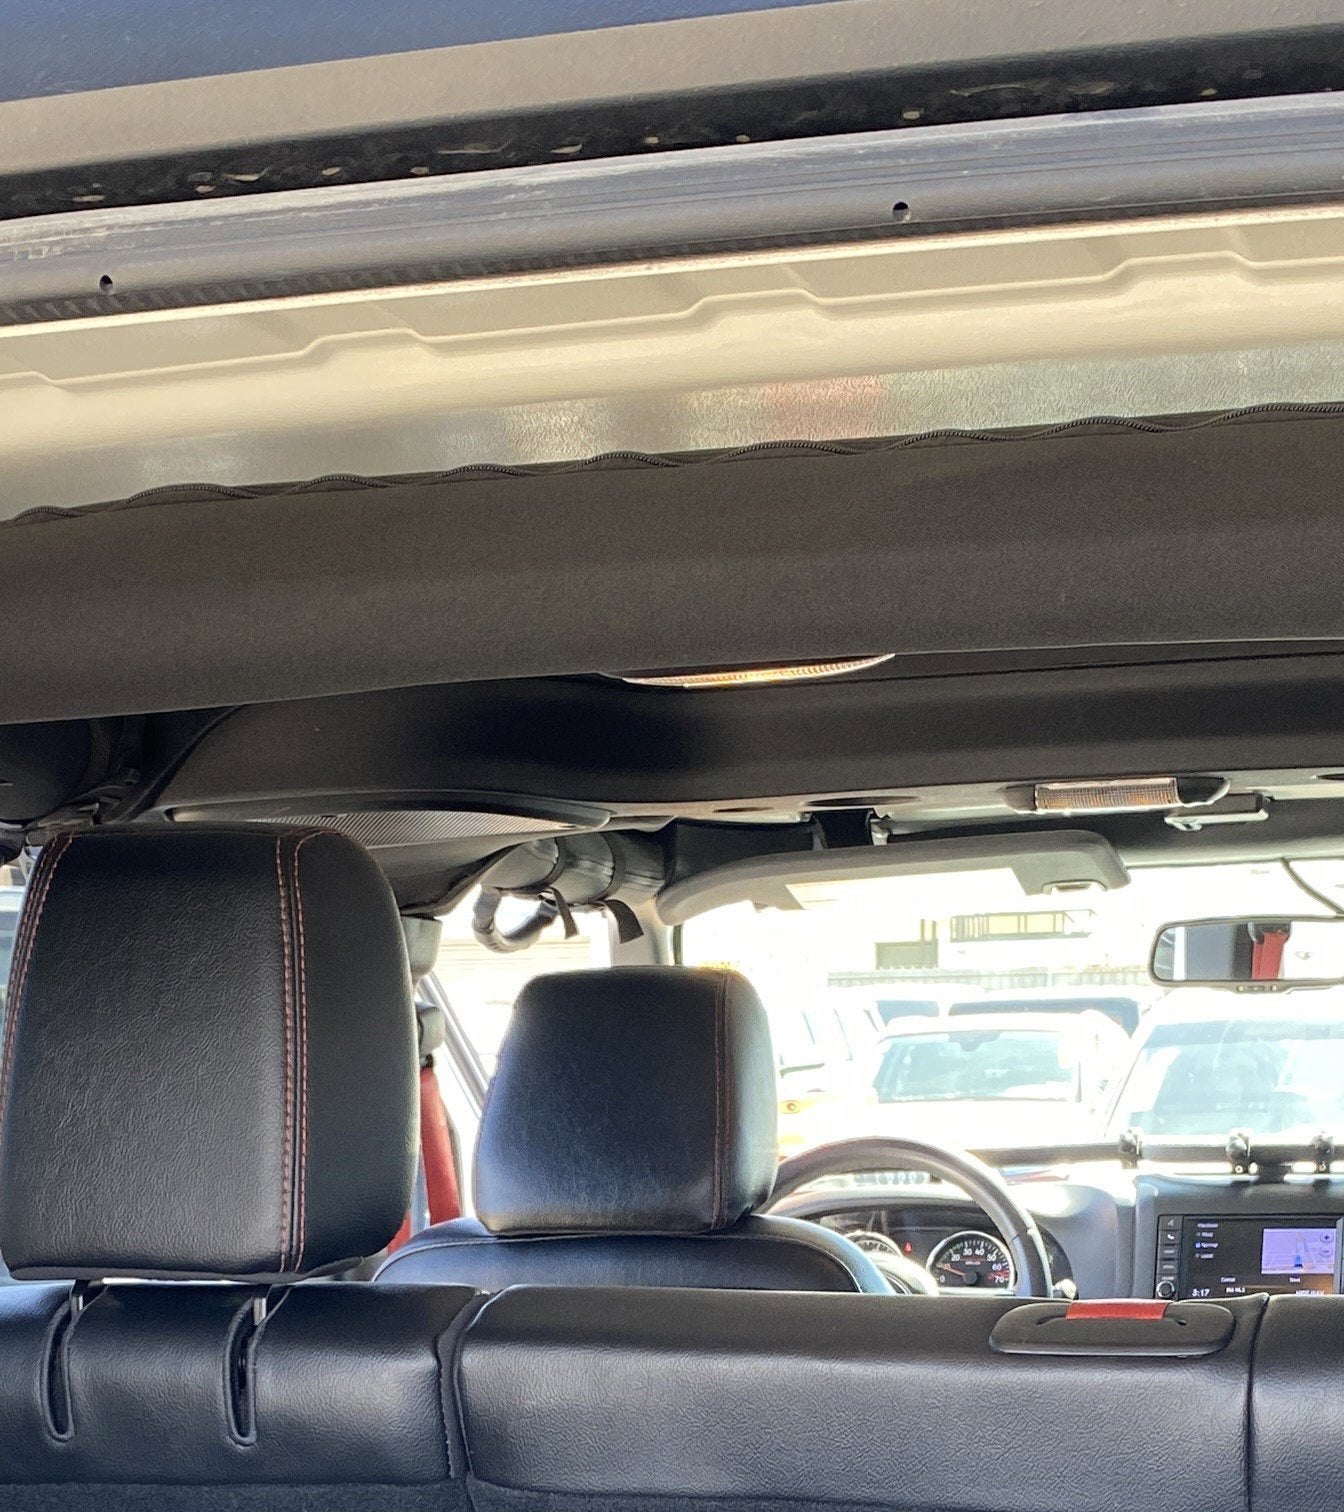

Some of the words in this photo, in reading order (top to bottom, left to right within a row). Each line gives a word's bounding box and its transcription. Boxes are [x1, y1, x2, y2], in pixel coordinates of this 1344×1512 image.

[963, 1248, 972, 1256] 30
[974, 1248, 985, 1256] 40
[951, 1253, 960, 1262] 20
[987, 1254, 997, 1262] 50
[992, 1263, 1002, 1271] 60
[994, 1275, 1005, 1283] 70
